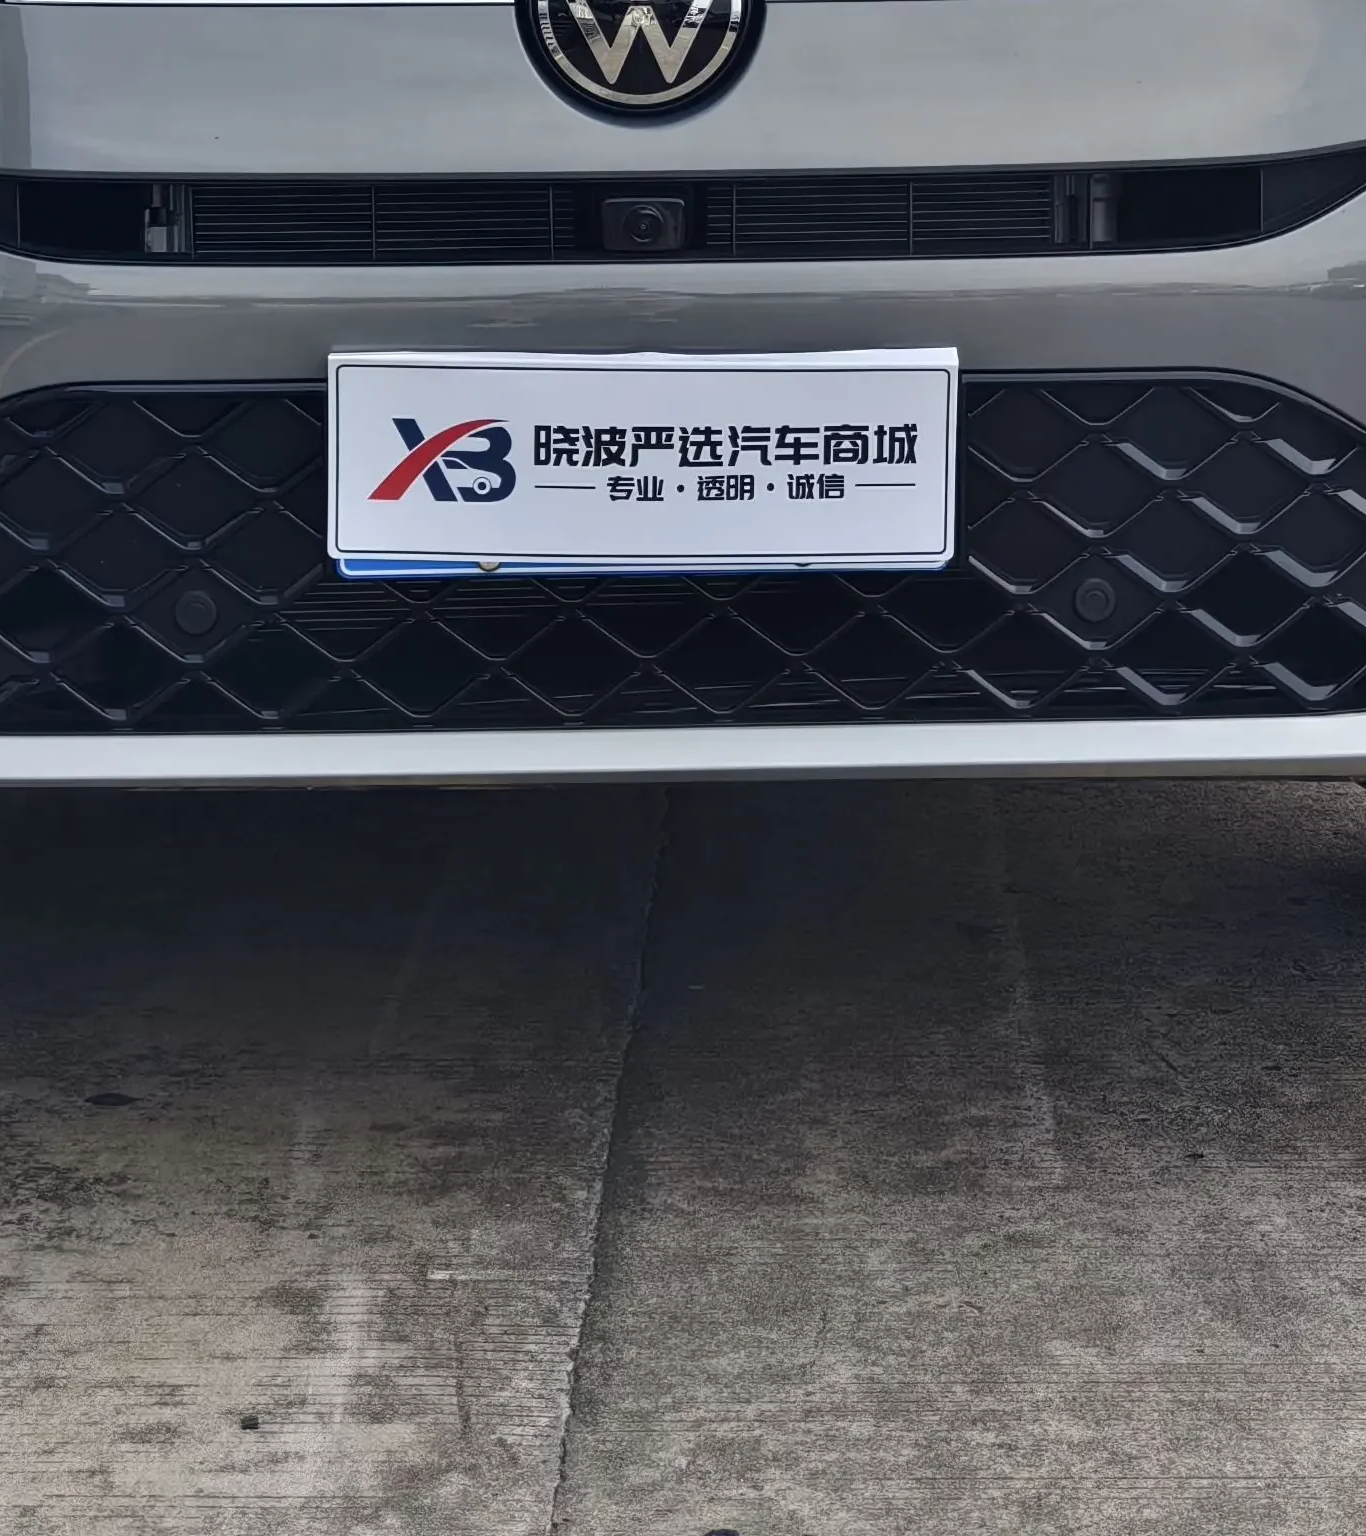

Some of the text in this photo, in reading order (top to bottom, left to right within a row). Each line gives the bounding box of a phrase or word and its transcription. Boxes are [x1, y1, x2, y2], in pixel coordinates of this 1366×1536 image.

[534, 424, 918, 468] 晓波严选汽车商城
